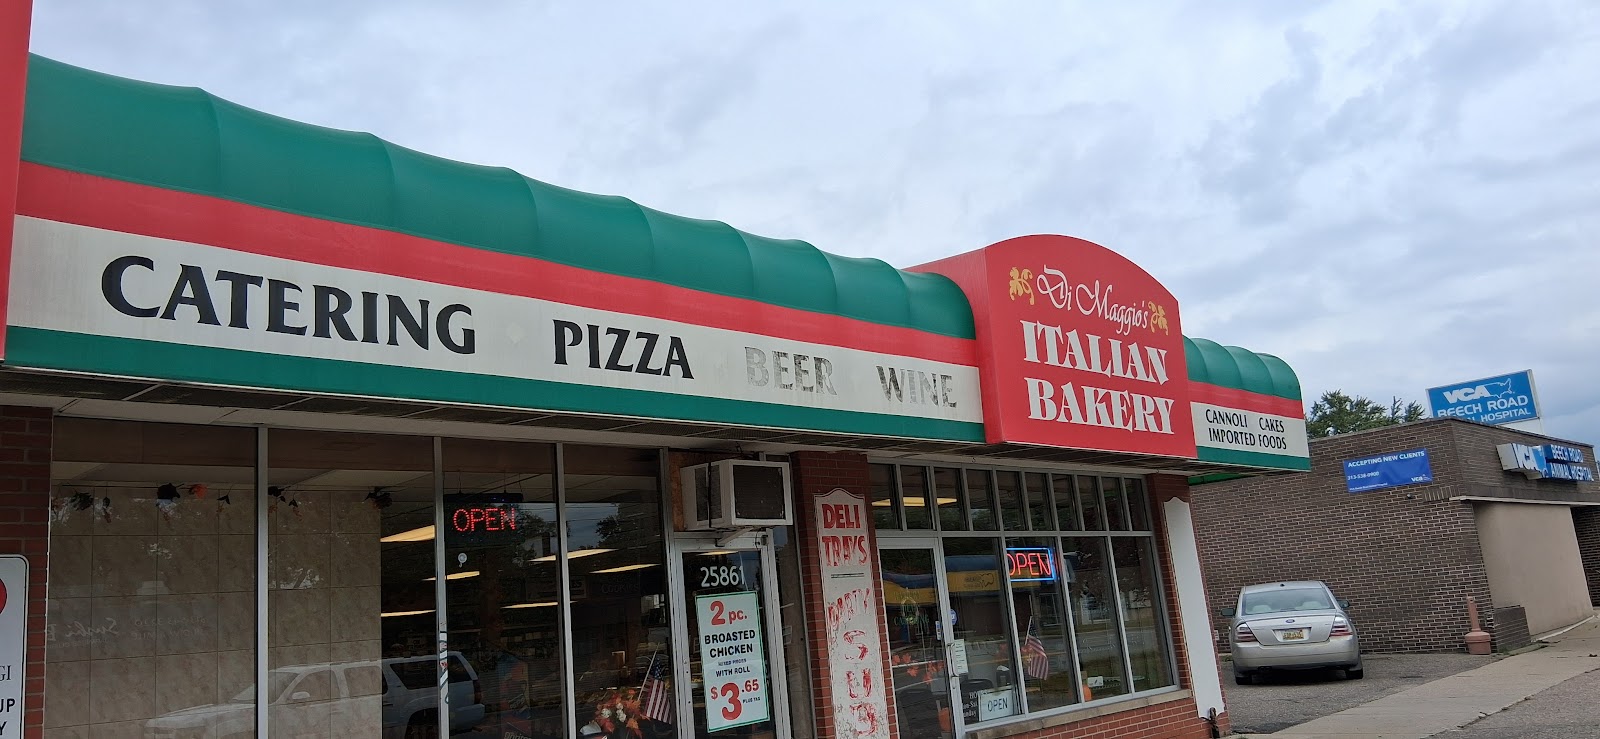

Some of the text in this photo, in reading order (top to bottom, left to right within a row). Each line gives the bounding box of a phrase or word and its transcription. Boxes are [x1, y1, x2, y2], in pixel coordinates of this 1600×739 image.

[1037, 264, 1149, 336] Di Maggio's
[101, 254, 958, 409] CATERING PIZZA BEER WINE
[1020, 320, 1169, 386] ITALIAN
[1024, 377, 1175, 435] BAKERY
[1443, 385, 1491, 404] VCA
[1437, 395, 1528, 418] BEECH ROAD
[1481, 407, 1531, 422] HOSPITAL
[1206, 409, 1285, 433] CANNOLI CAKES
[1208, 427, 1287, 450] IMPORTED FOODS
[1348, 450, 1425, 468] ACCEPTING NEW CLIENTS
[1551, 444, 1584, 463] BEECH ROAD
[453, 507, 517, 532] OPEN
[822, 503, 861, 529] DELI
[1007, 553, 1052, 576] OPEN
[700, 565, 746, 588] 25861
[710, 600, 748, 626] 2 pc.
[704, 629, 756, 645] BROASTED
[709, 643, 753, 659] CHICKEN
[716, 666, 751, 677] WITH ROLL
[987, 697, 1008, 713] OPEN
